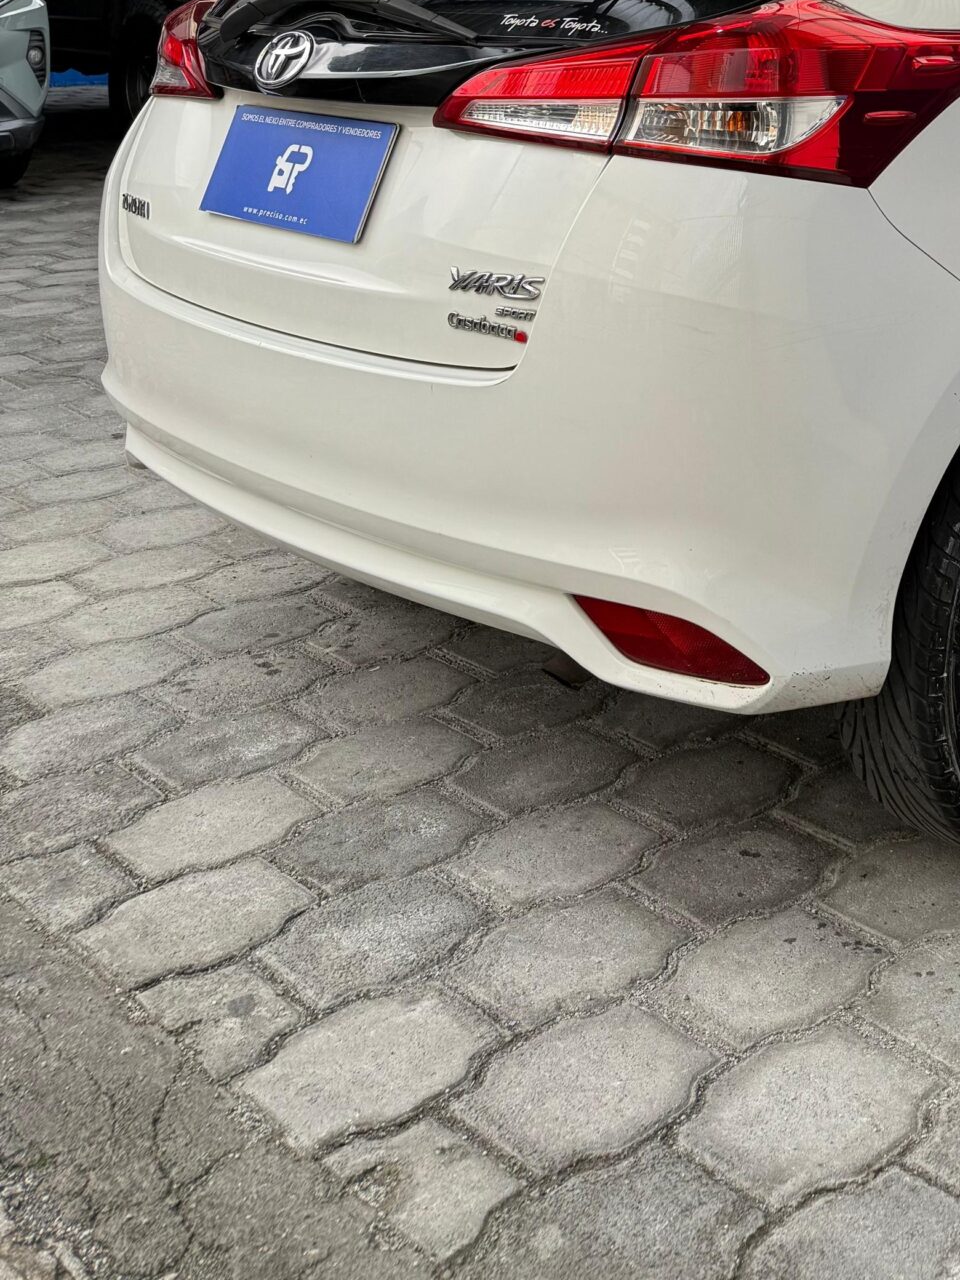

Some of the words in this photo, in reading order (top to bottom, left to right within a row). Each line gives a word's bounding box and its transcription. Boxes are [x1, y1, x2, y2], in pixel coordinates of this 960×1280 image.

[500, 14, 539, 32] Toyota
[541, 18, 560, 29] es
[241, 112, 259, 123] SOMOS
[265, 115, 279, 124] NEXO
[278, 118, 297, 127] ENTRE
[295, 119, 338, 133] COMPRADORES
[342, 127, 382, 139] VENDEDORES
[243, 206, 308, 225] www.preciso.com.ec
[448, 265, 545, 301] YARIS
[495, 306, 537, 322] SPORT
